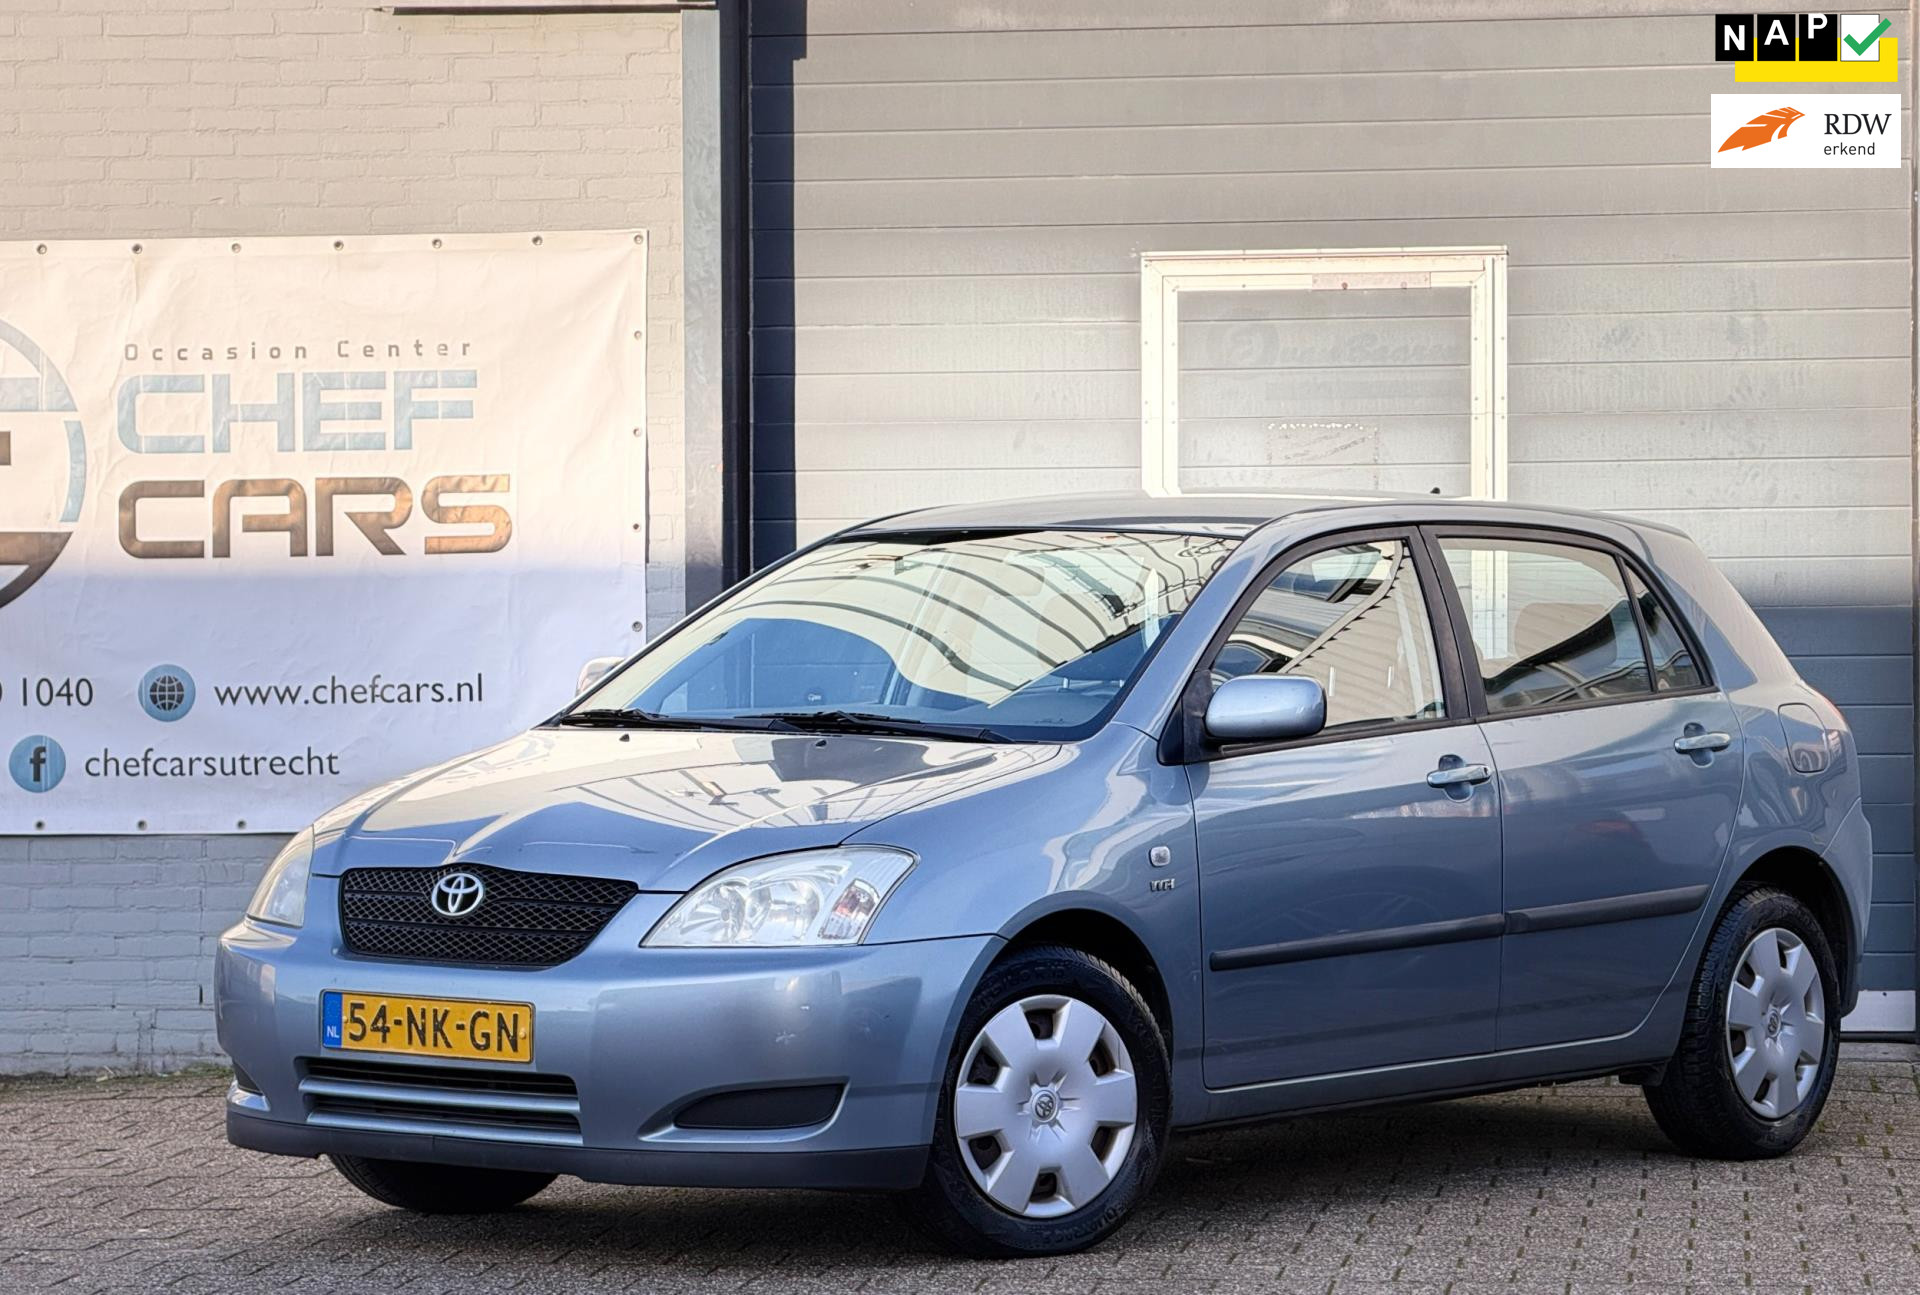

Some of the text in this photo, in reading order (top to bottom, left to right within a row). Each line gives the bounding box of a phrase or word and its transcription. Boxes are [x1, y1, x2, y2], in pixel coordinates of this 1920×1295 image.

[125, 338, 472, 362] Occasion Center
[117, 369, 478, 454] CHEF
[118, 473, 512, 560] CARS
[22, 677, 94, 707] 1040
[213, 672, 484, 706] www.chefcars.nl
[84, 746, 340, 778] chefcarsutrecht
[326, 1026, 340, 1039] NL
[349, 1002, 519, 1053] 54-NK-GN
